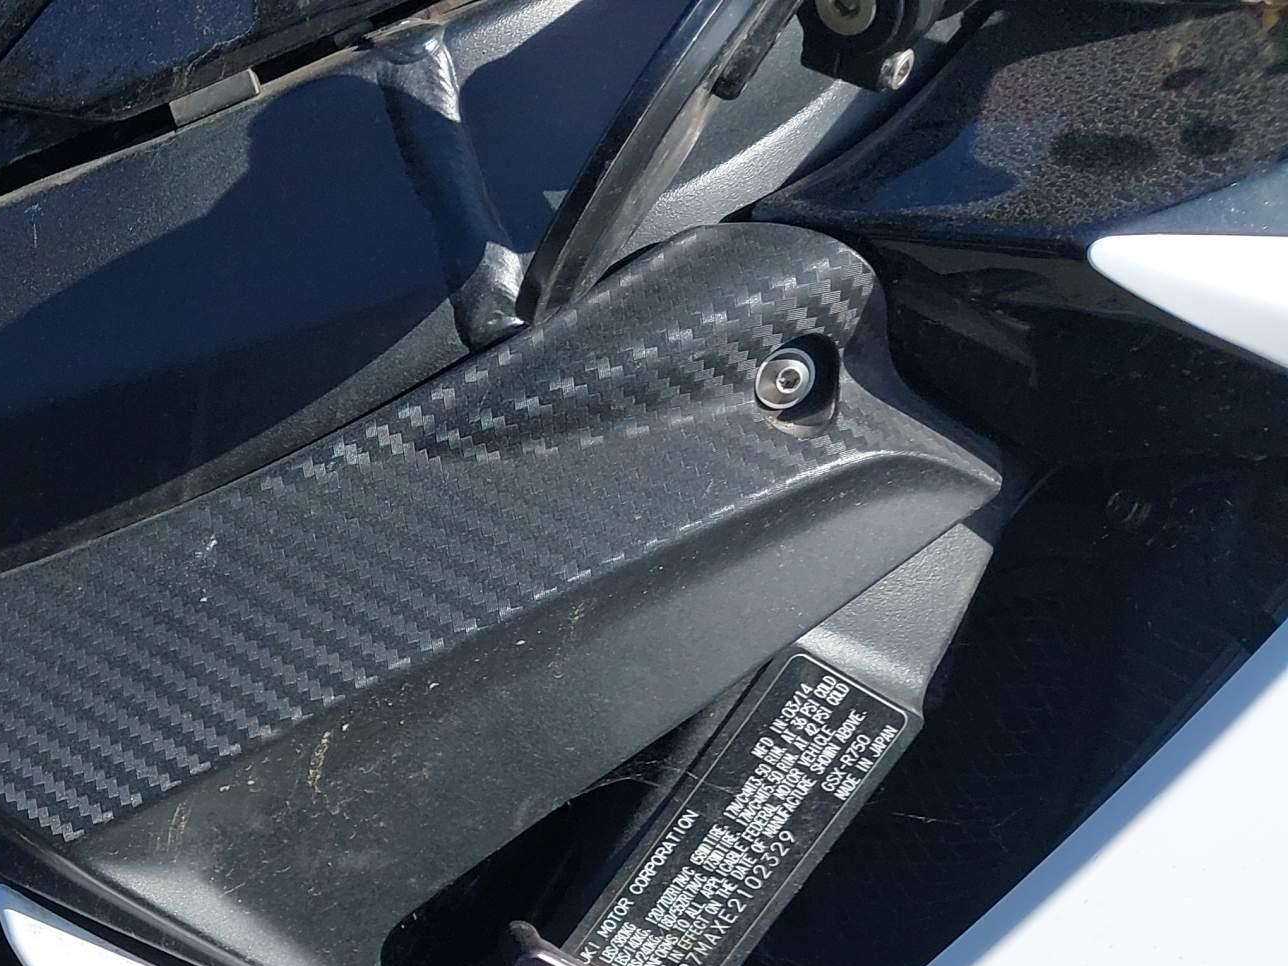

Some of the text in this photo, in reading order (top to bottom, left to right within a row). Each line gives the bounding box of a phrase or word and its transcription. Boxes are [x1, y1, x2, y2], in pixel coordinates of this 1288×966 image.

[780, 728, 797, 744] AT
[789, 715, 807, 730] 36
[798, 698, 820, 717] PSI
[813, 675, 837, 698] COLD
[811, 705, 832, 724] PSI
[825, 682, 849, 706] COLD
[750, 736, 774, 758] MFD
[792, 735, 809, 751] AT
[803, 722, 822, 736] 42
[820, 733, 871, 791] GSX-R750
[833, 724, 898, 800] MADE IN JAPAN
[666, 948, 685, 963] IN
[676, 914, 710, 950] EFFECT
[704, 899, 723, 915] ON
[714, 878, 738, 898] THE
[729, 852, 757, 880] DATE
[750, 837, 768, 853] OF
[761, 774, 816, 838] MANUFACTURE
[809, 742, 841, 774] SHOWN
[672, 918, 690, 932] TO
[684, 901, 707, 919] ALL
[699, 841, 749, 899] APPLICABLE
[740, 802, 781, 842] FEDERAL
[772, 767, 804, 800] MOTOR
[797, 724, 836, 766] VEHICLE
[596, 897, 634, 938] MOTOR
[628, 808, 699, 894] CORPORATION
